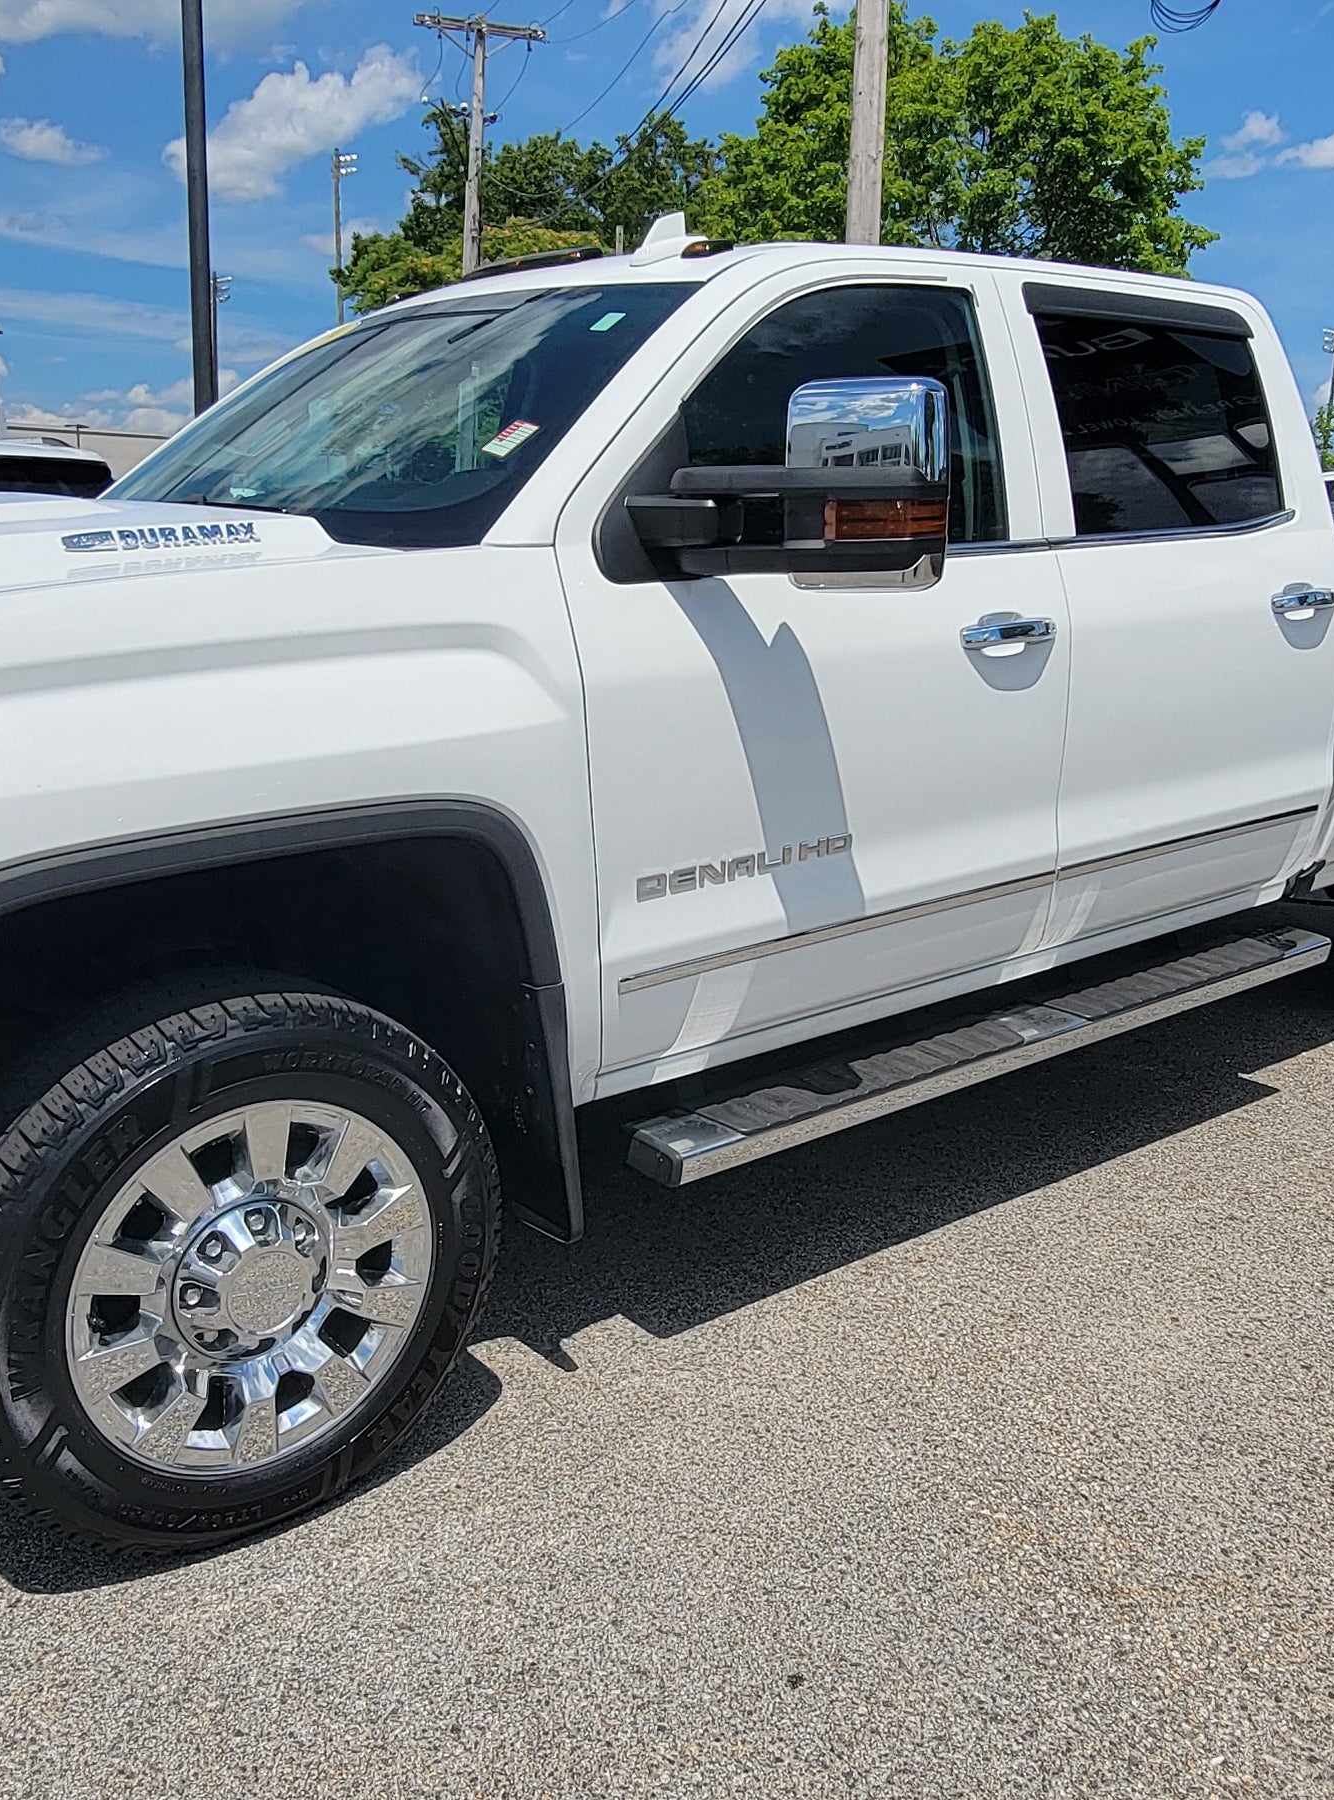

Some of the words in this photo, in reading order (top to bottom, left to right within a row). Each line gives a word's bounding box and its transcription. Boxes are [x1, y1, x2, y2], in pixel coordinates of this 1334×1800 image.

[117, 522, 261, 551] DURAMAX
[636, 844, 792, 903] DENALI
[798, 833, 852, 862] HD
[6, 1113, 146, 1400] WRANGLER
